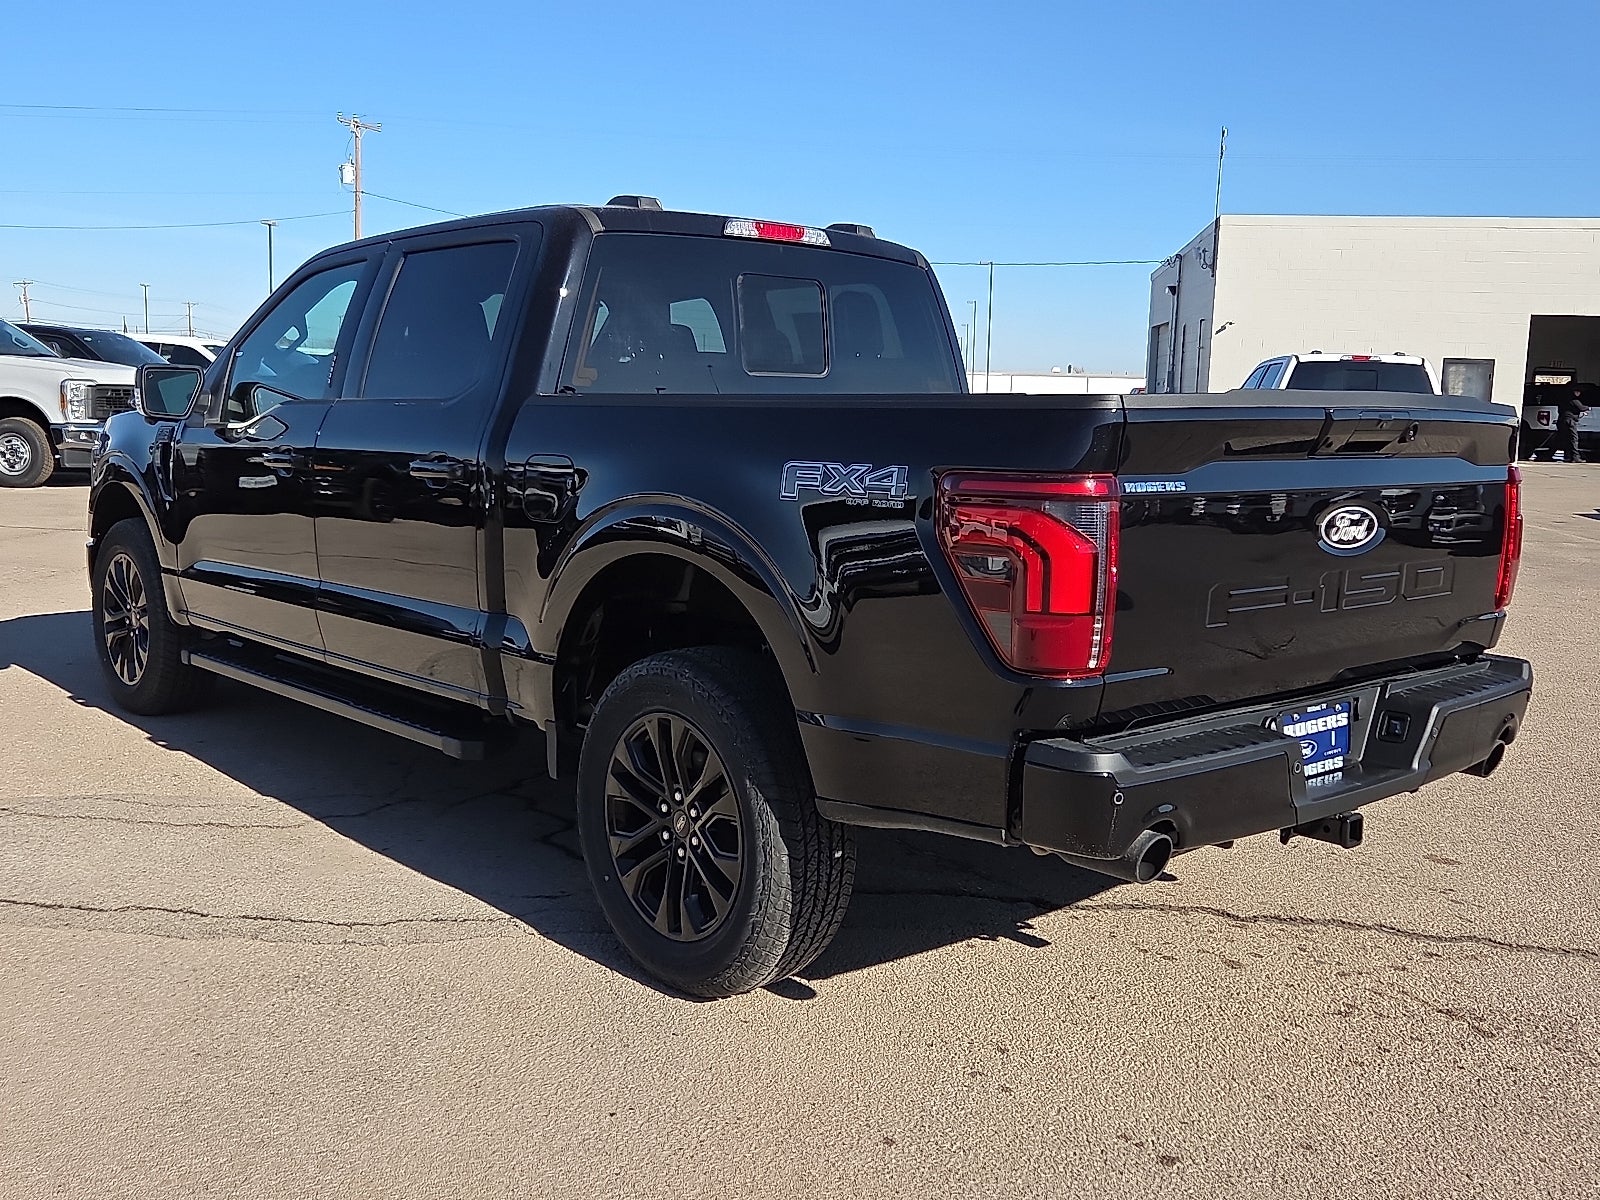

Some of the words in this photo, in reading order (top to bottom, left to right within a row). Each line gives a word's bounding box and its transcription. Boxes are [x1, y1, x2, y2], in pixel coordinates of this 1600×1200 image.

[780, 460, 908, 500] FX4
[1124, 481, 1187, 493] ROGERS
[1328, 510, 1371, 543] Ford
[1205, 559, 1455, 628] F-150
[1283, 712, 1349, 738] ROGERS
